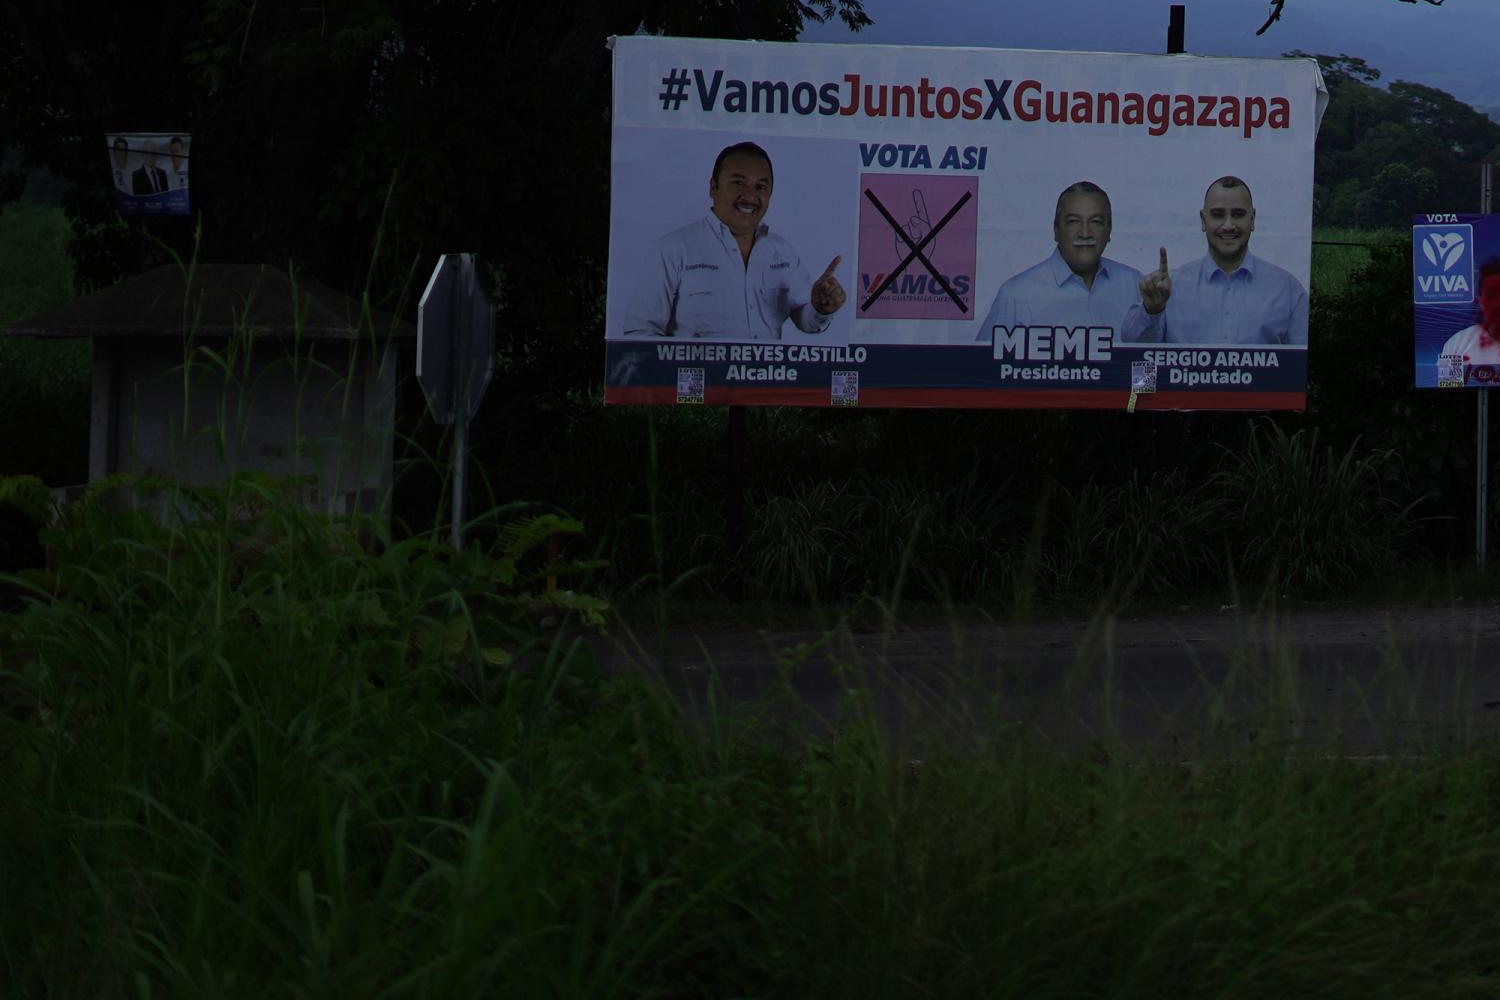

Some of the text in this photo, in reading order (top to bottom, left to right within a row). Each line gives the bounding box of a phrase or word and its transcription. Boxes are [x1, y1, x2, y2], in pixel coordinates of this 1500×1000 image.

[659, 68, 1290, 138] #VamosJuntosXGuanagazapa
[859, 143, 988, 170] VOTA ASI
[1426, 213, 1459, 223] VOTA
[861, 273, 970, 295] VAMOS
[1418, 275, 1469, 292] VIVA
[992, 326, 1113, 361] MEME
[656, 345, 867, 363] WEIMER REYES CASTILLO
[1143, 351, 1279, 368] SERGIO ARANA
[726, 365, 798, 381] Alcalde
[1000, 364, 1101, 381] Presidente
[1169, 368, 1253, 386] Diputado
